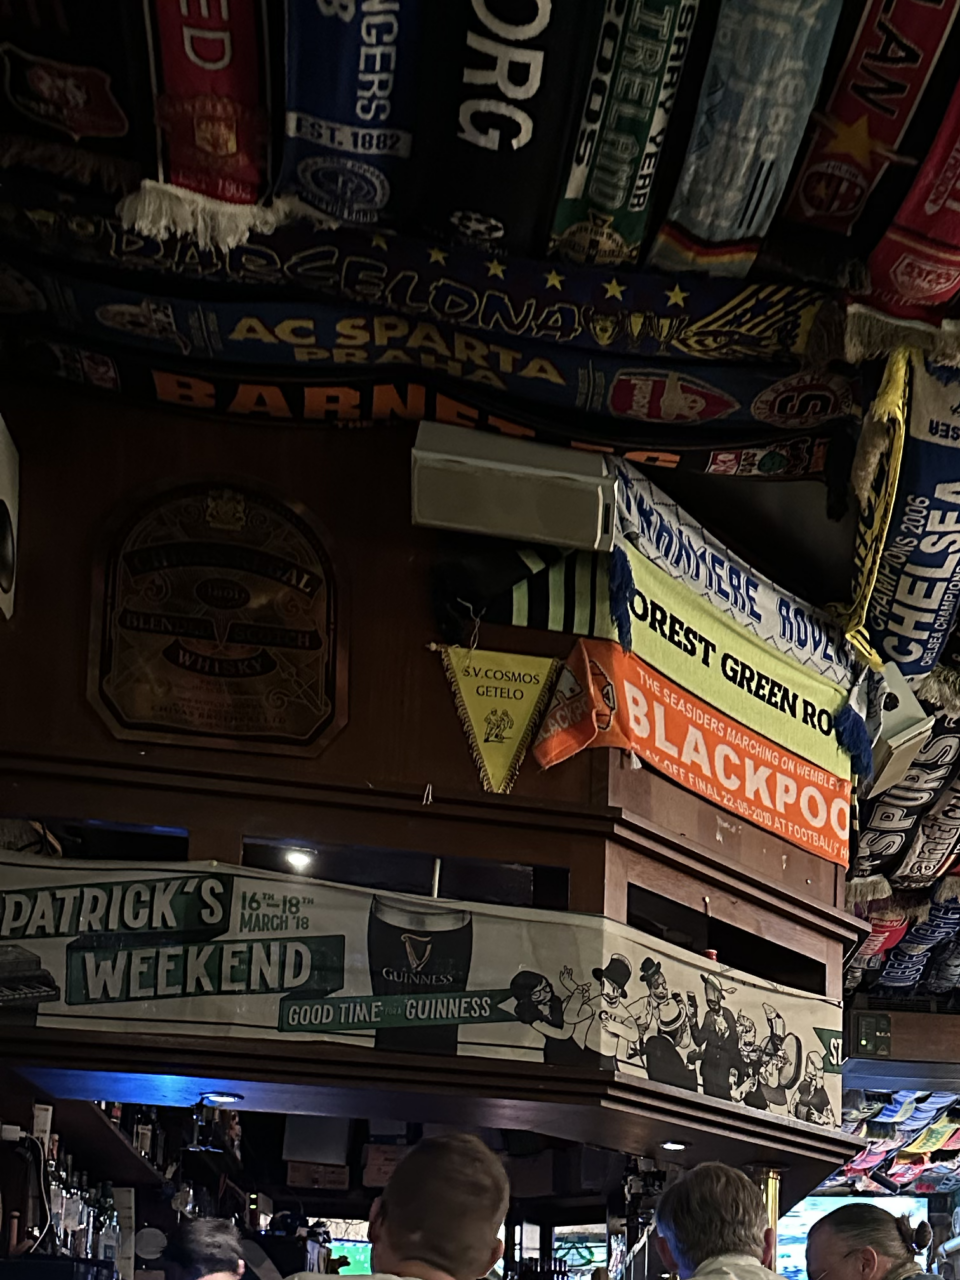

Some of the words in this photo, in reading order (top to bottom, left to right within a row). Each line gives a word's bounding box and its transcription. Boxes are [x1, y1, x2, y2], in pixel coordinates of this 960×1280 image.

[588, 3, 676, 210] IRELAND
[351, 131, 402, 151] 1882
[629, 127, 667, 211] YEAR
[228, 315, 317, 346] AC
[335, 314, 567, 387] SPARTA
[293, 346, 508, 392] PRAHA
[871, 536, 917, 631] CHAMPIONS
[900, 494, 931, 538] 2006
[177, 650, 264, 675] WHISKY
[628, 589, 717, 667] OREST
[721, 652, 799, 719] GREEN
[476, 684, 524, 701] GETELO
[636, 667, 662, 702] THE
[662, 684, 726, 740] SEASIDERS
[726, 726, 780, 766] MARCHING
[780, 756, 797, 773] ON
[797, 760, 841, 791] WEMBLEY
[688, 767, 722, 803] FINAL
[721, 791, 773, 827] 22-05-2010
[773, 817, 788, 834] AT
[0, 876, 226, 937] PATRICK'S
[240, 911, 289, 933] MARCH
[82, 941, 313, 1000] WEEKEND
[382, 966, 454, 986] GUINNESS
[288, 1003, 336, 1026] GOOD
[338, 1000, 383, 1024] TIME
[405, 996, 492, 1020] GUINNESS
